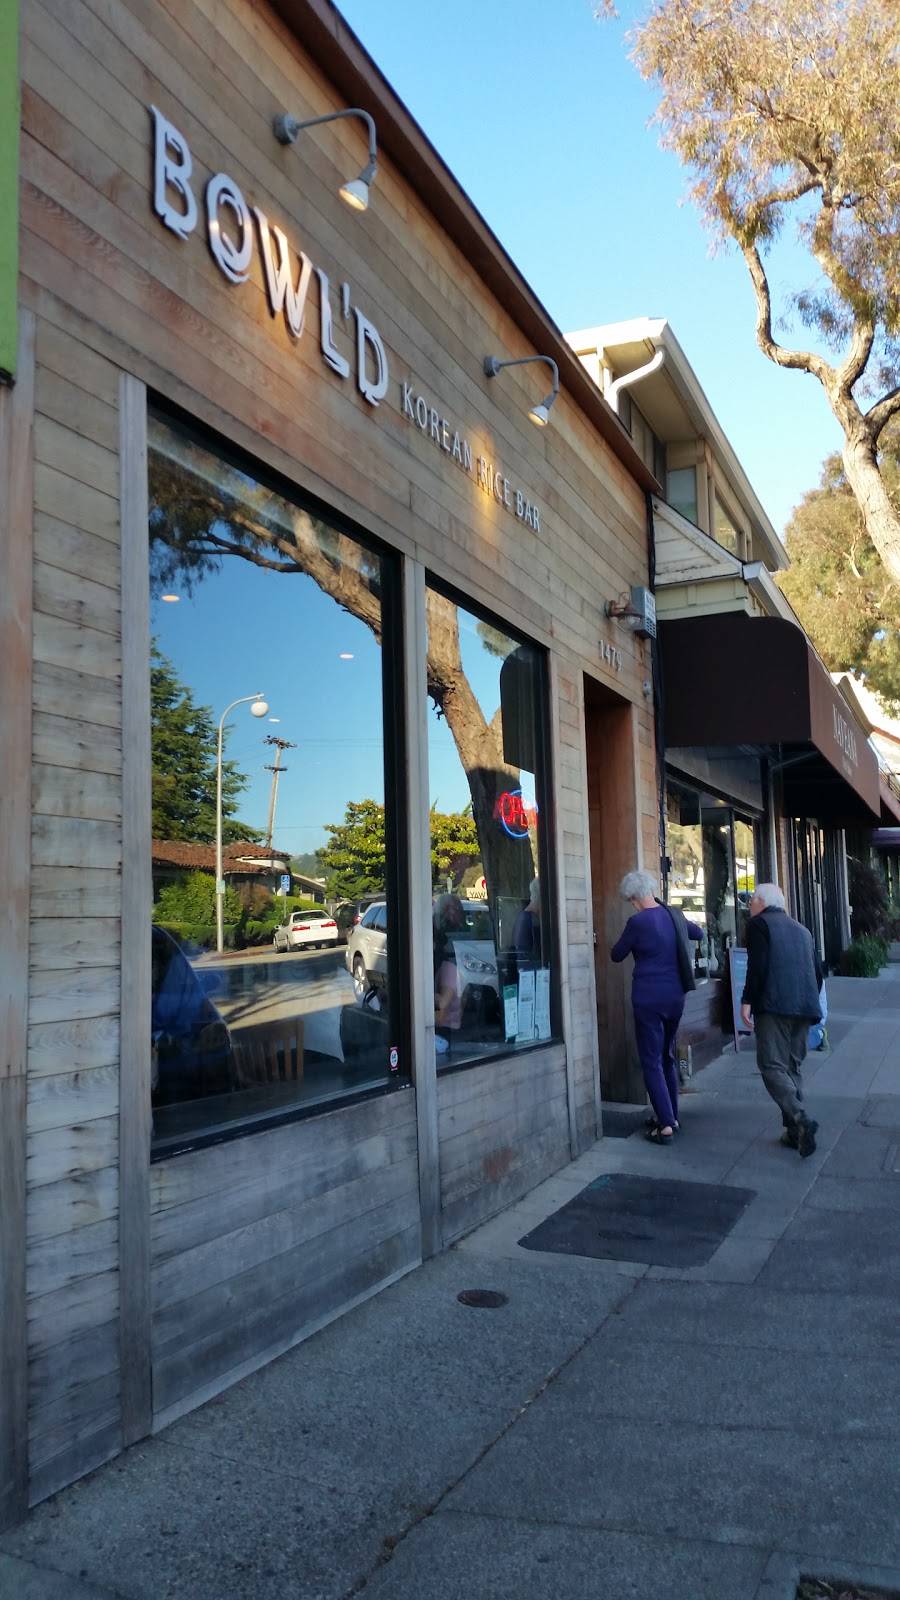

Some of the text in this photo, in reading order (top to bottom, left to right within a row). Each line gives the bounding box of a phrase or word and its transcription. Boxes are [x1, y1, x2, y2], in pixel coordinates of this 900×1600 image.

[151, 104, 388, 407] BOWL'D
[402, 381, 541, 533] KOREAN RICE BAR
